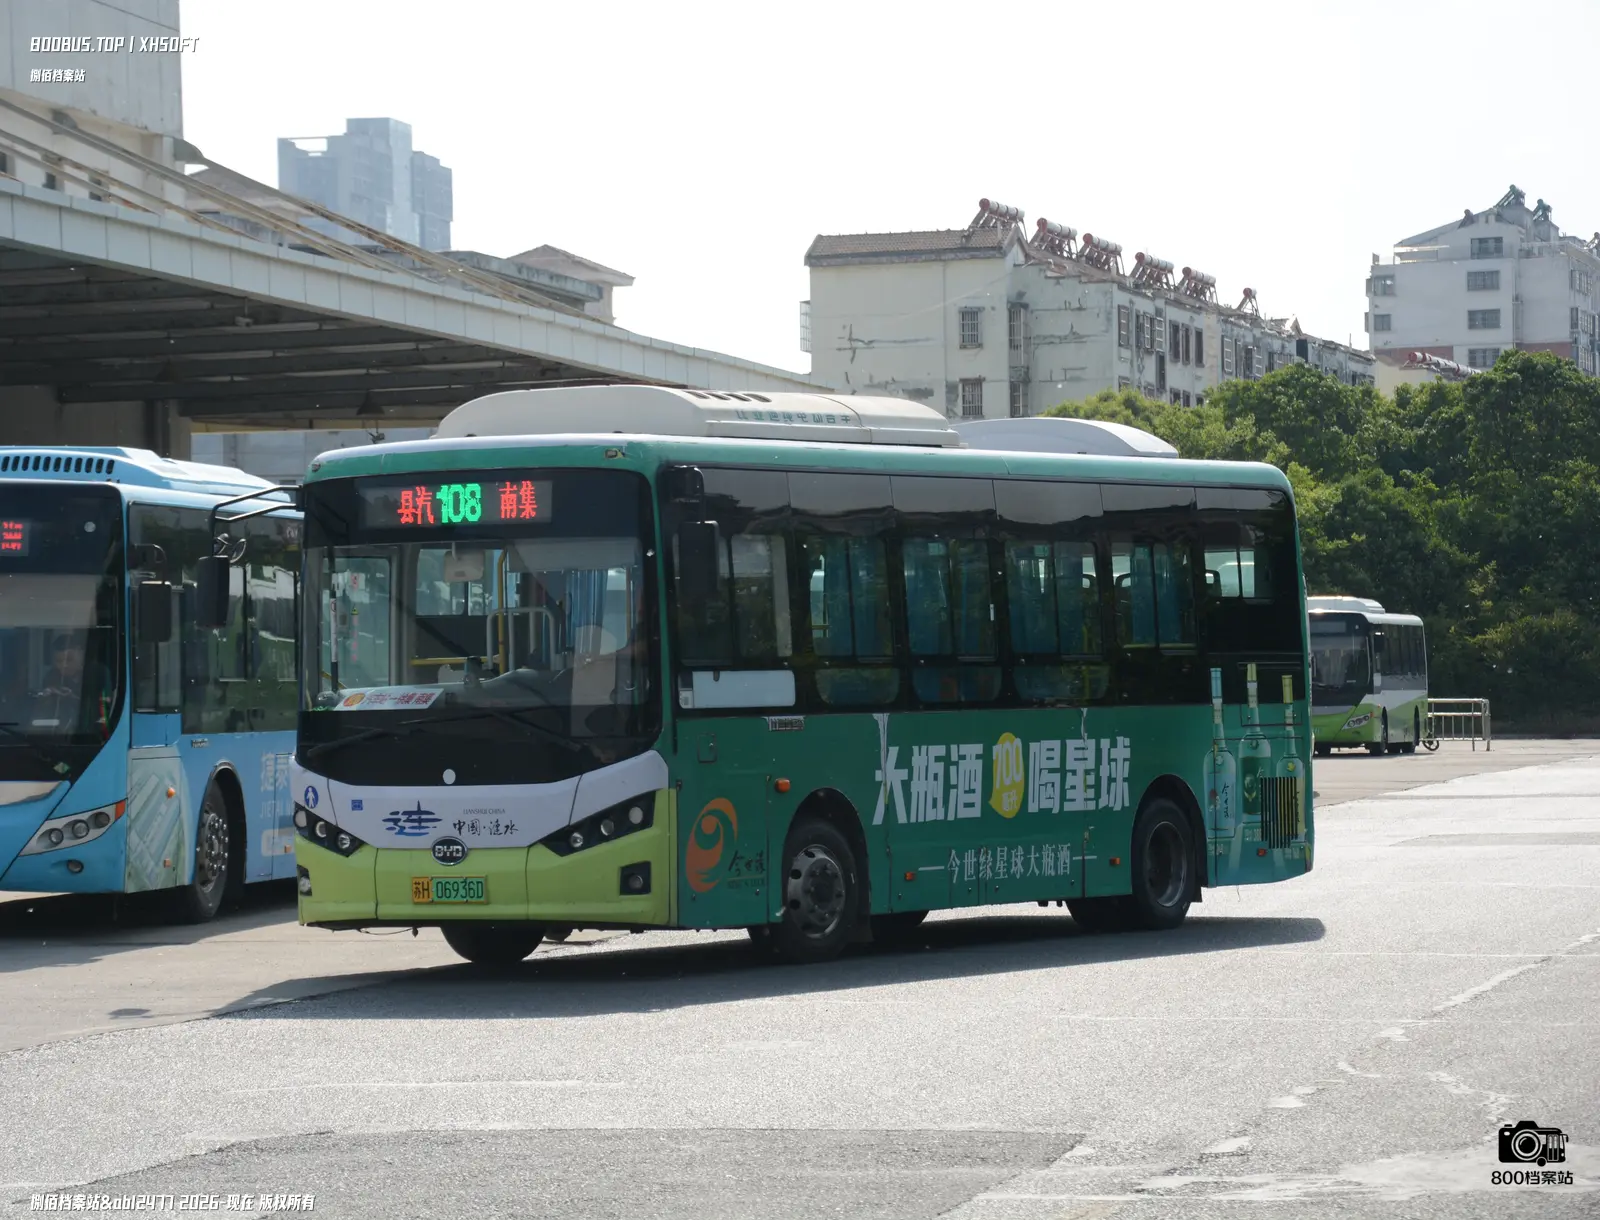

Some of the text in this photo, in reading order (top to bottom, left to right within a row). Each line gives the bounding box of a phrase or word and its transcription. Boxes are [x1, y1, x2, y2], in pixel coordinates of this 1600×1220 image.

[397, 480, 537, 524] 县汽 108 南集
[872, 743, 984, 825] 大瓶酒
[992, 737, 1023, 789] 700
[1028, 736, 1131, 814] 喝星球
[435, 845, 462, 857] BYD
[436, 880, 484, 899] 06936D
